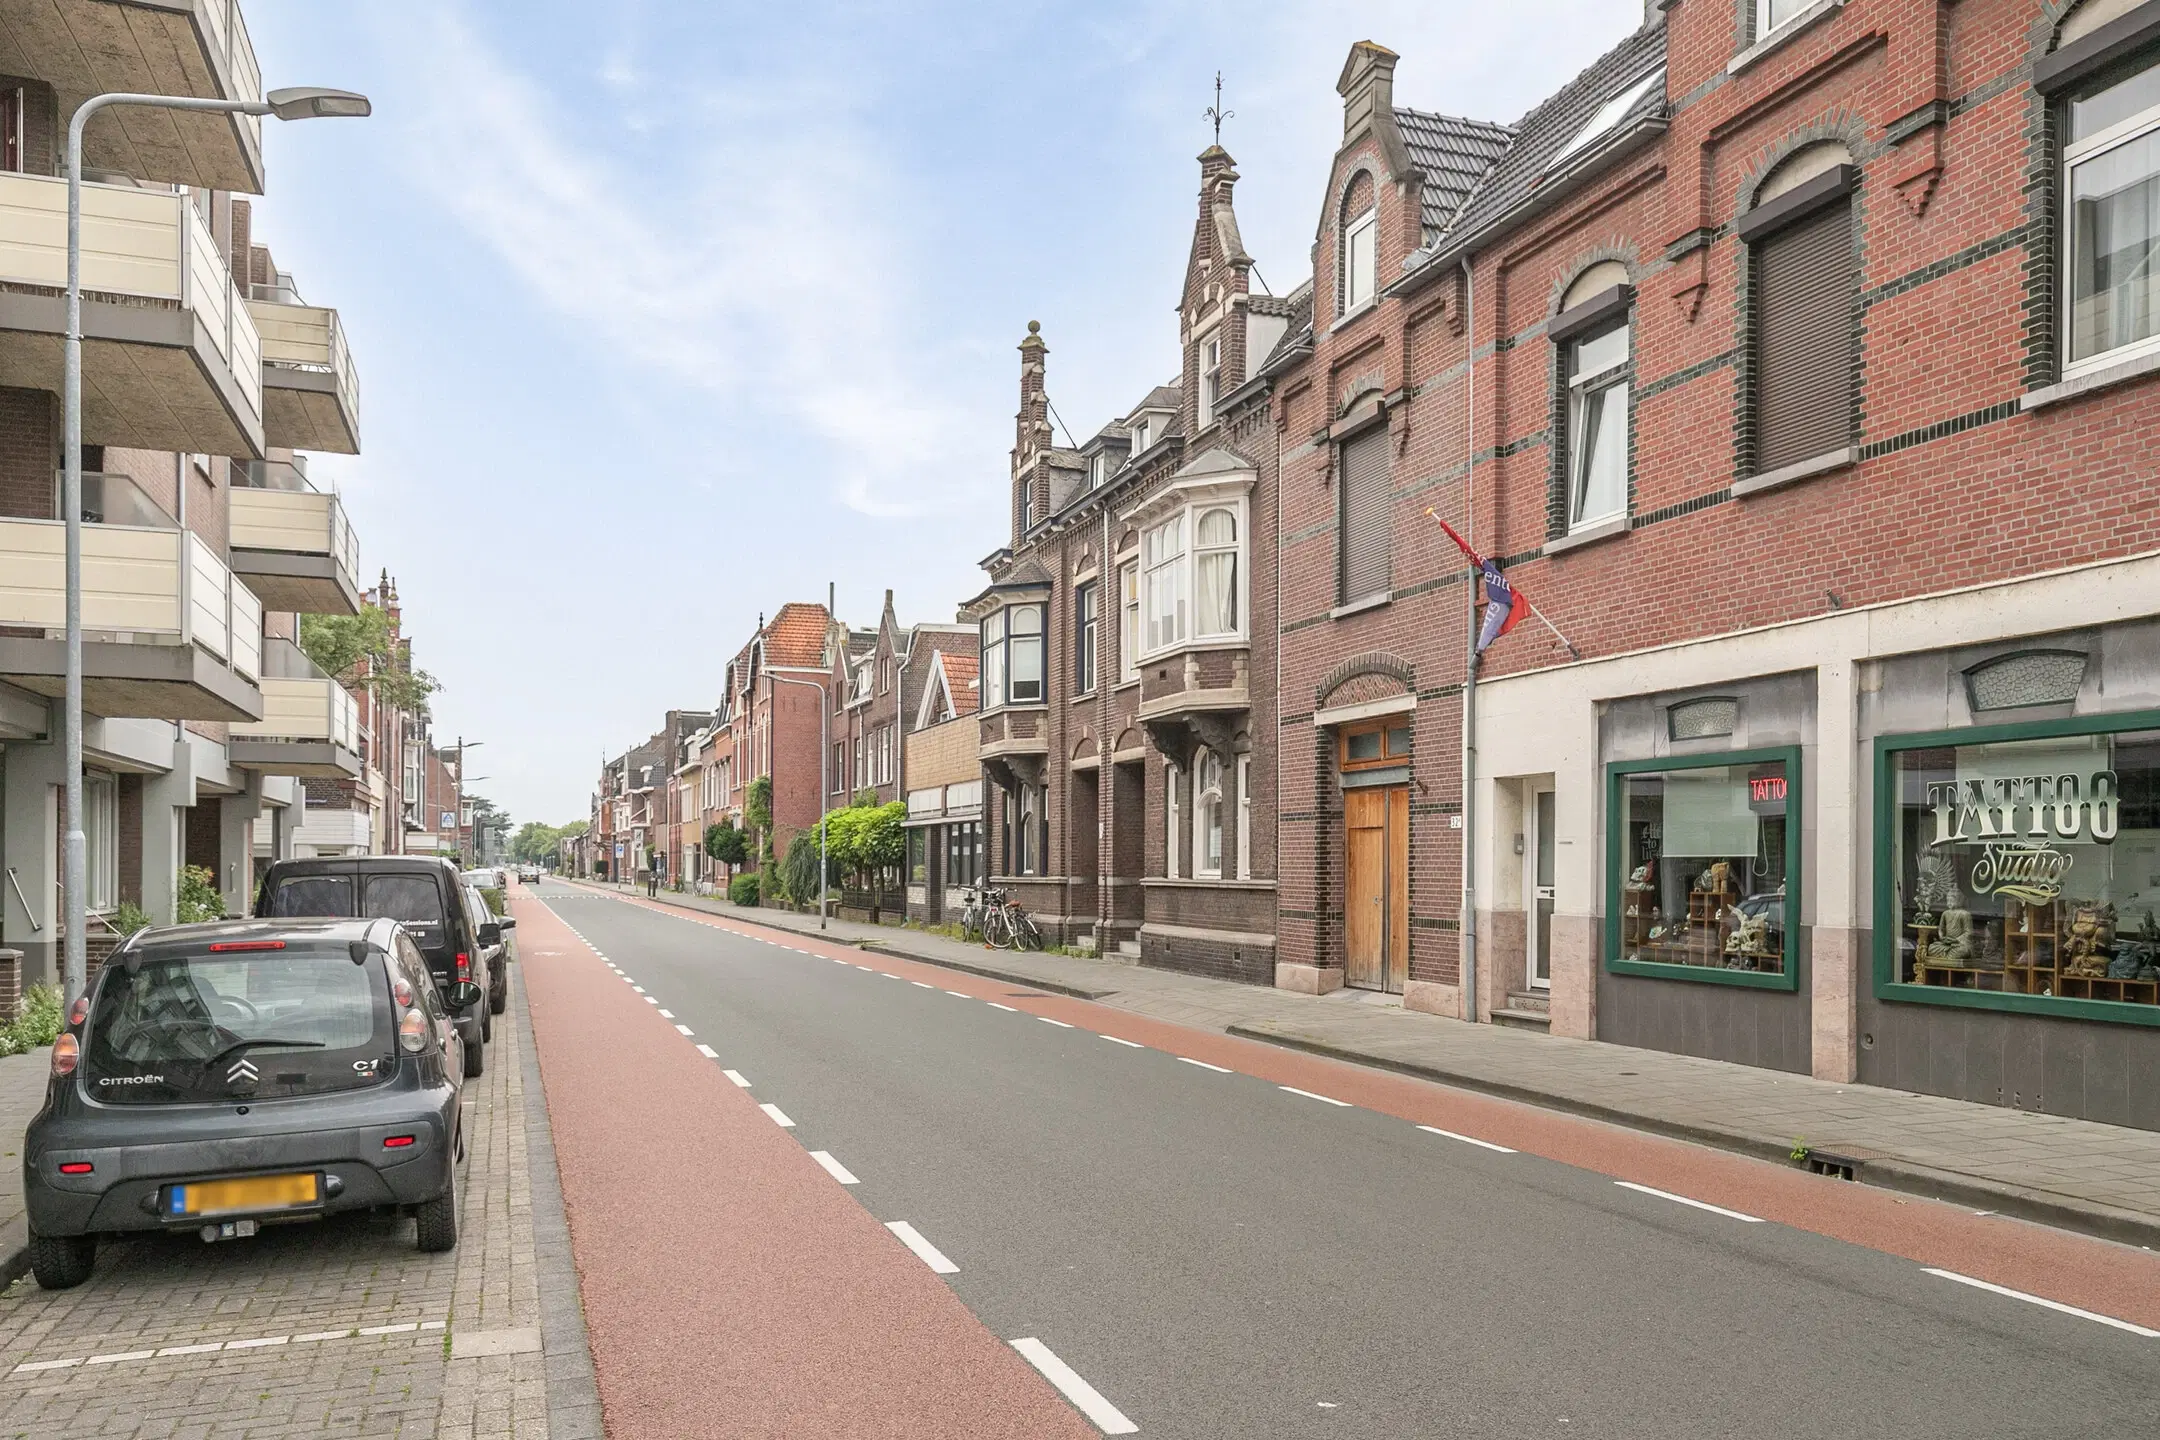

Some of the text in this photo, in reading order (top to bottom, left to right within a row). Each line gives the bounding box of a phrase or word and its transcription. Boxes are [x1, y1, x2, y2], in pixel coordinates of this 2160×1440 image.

[1926, 769, 2121, 848] TATTOO
[1971, 840, 2073, 894] Studio
[99, 1074, 164, 1086] CITROËN
[352, 1058, 379, 1070] C1
